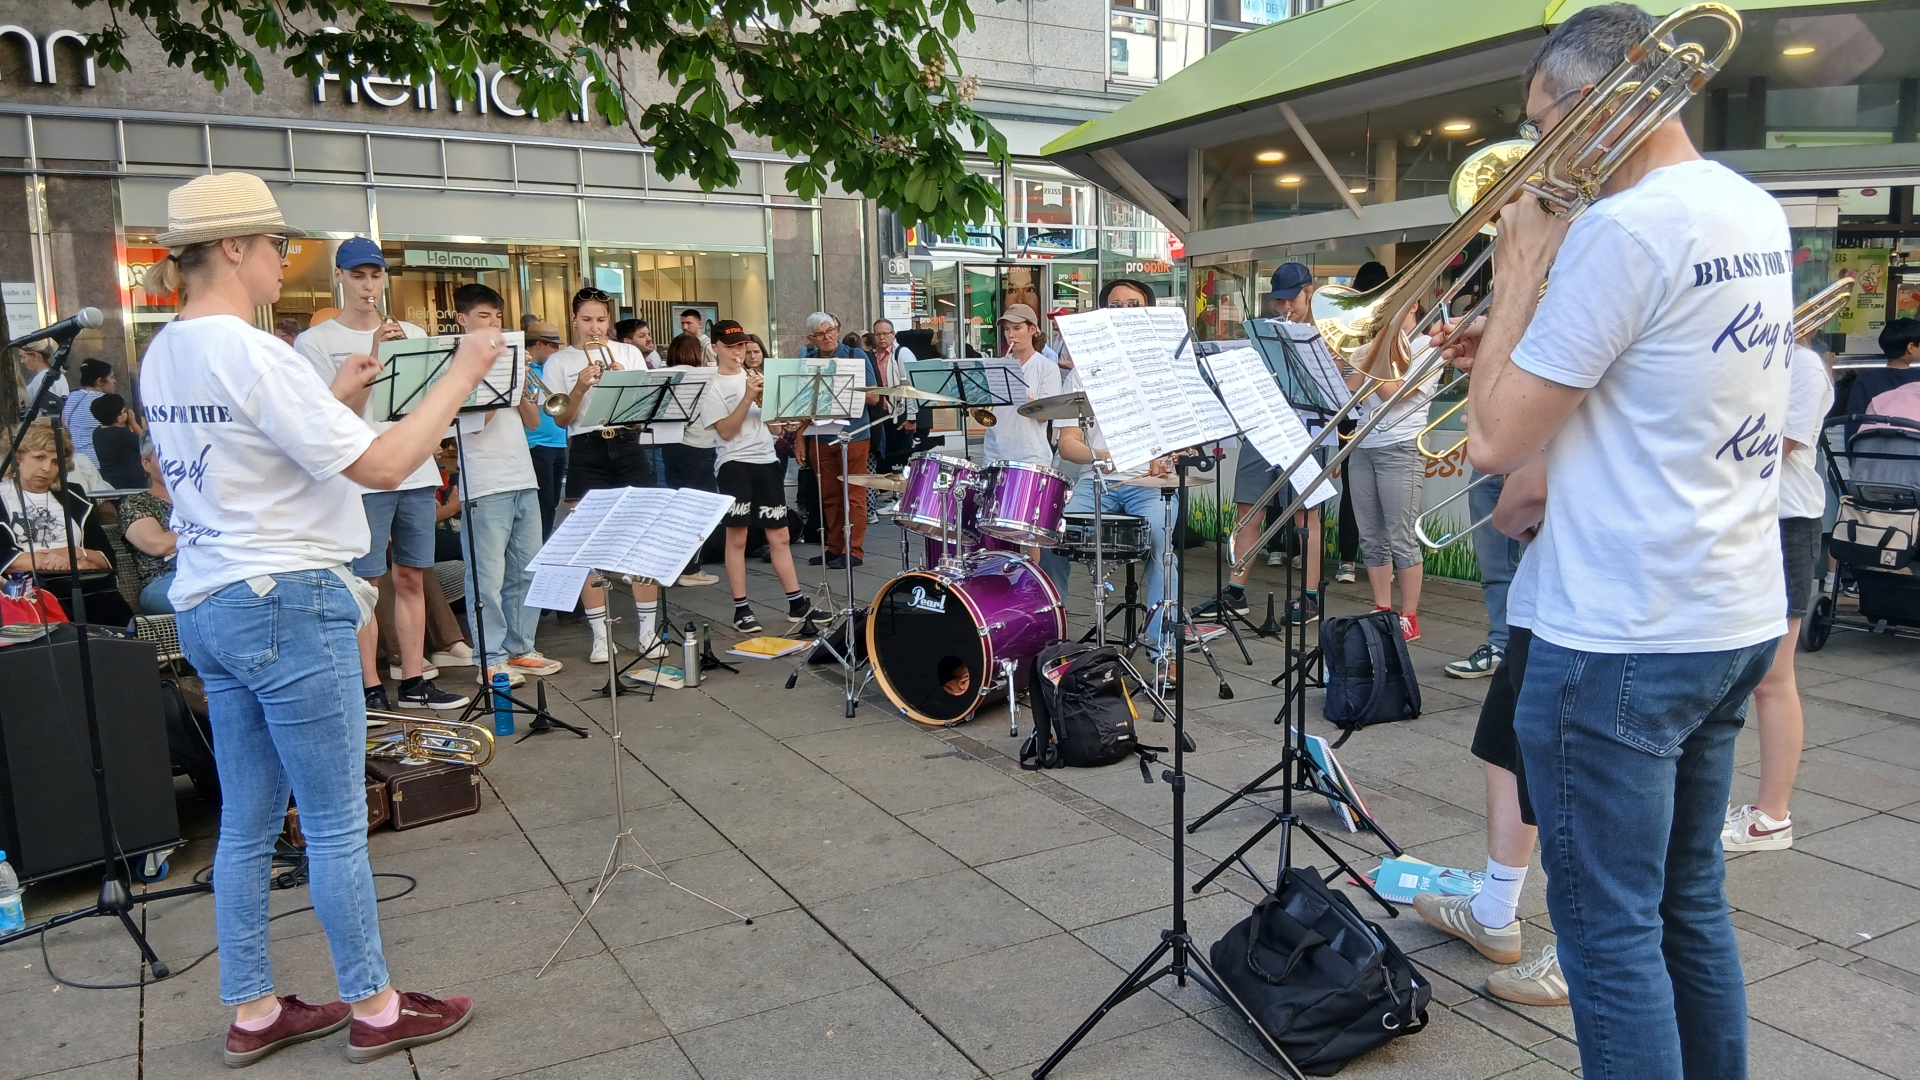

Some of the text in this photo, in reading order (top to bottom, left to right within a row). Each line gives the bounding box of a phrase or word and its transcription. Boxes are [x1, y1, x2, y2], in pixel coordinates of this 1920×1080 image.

[888, 260, 905, 273] 66
[1693, 253, 1762, 288] BRASS
[1761, 251, 1785, 276] FOR
[1711, 300, 1780, 370] King
[145, 405, 168, 422] ASS
[188, 405, 233, 423] THE
[907, 586, 946, 609] Pearl
